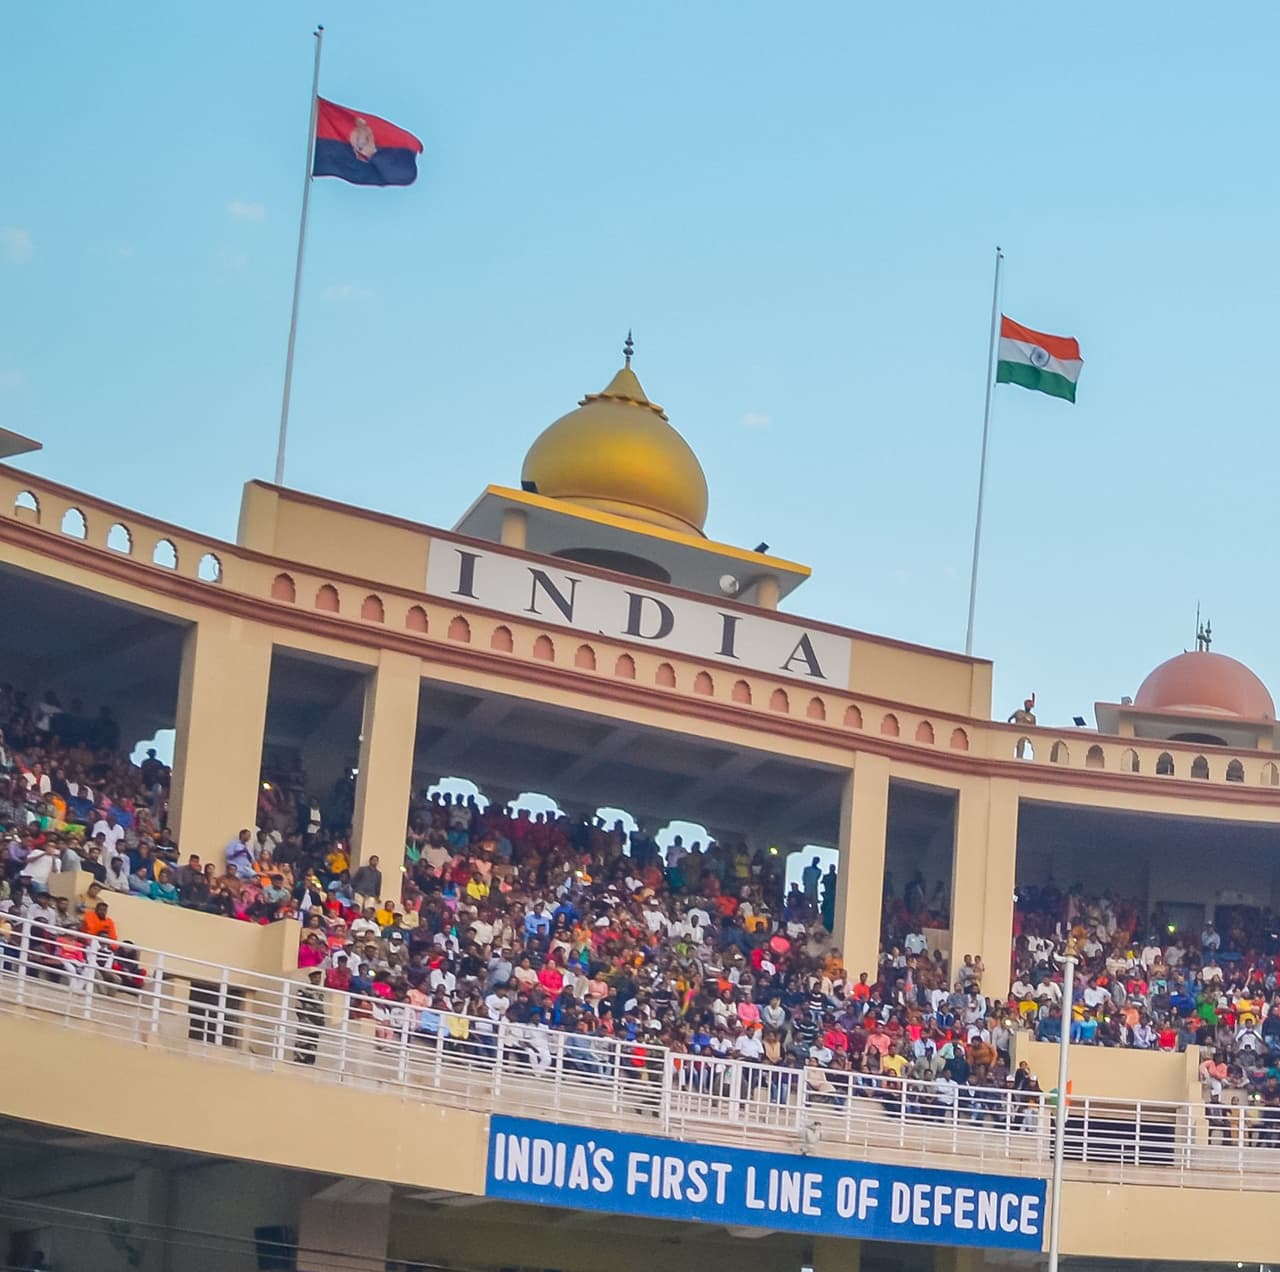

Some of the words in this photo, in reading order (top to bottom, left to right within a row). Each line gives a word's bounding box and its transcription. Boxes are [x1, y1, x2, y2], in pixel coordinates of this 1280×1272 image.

[451, 548, 829, 680] INDIA
[494, 1132, 614, 1192] INDIA'S
[626, 1151, 732, 1205] FIRST
[746, 1165, 823, 1217] LINE
[836, 1176, 880, 1220] OF
[890, 1181, 1040, 1235] DEFENCE
